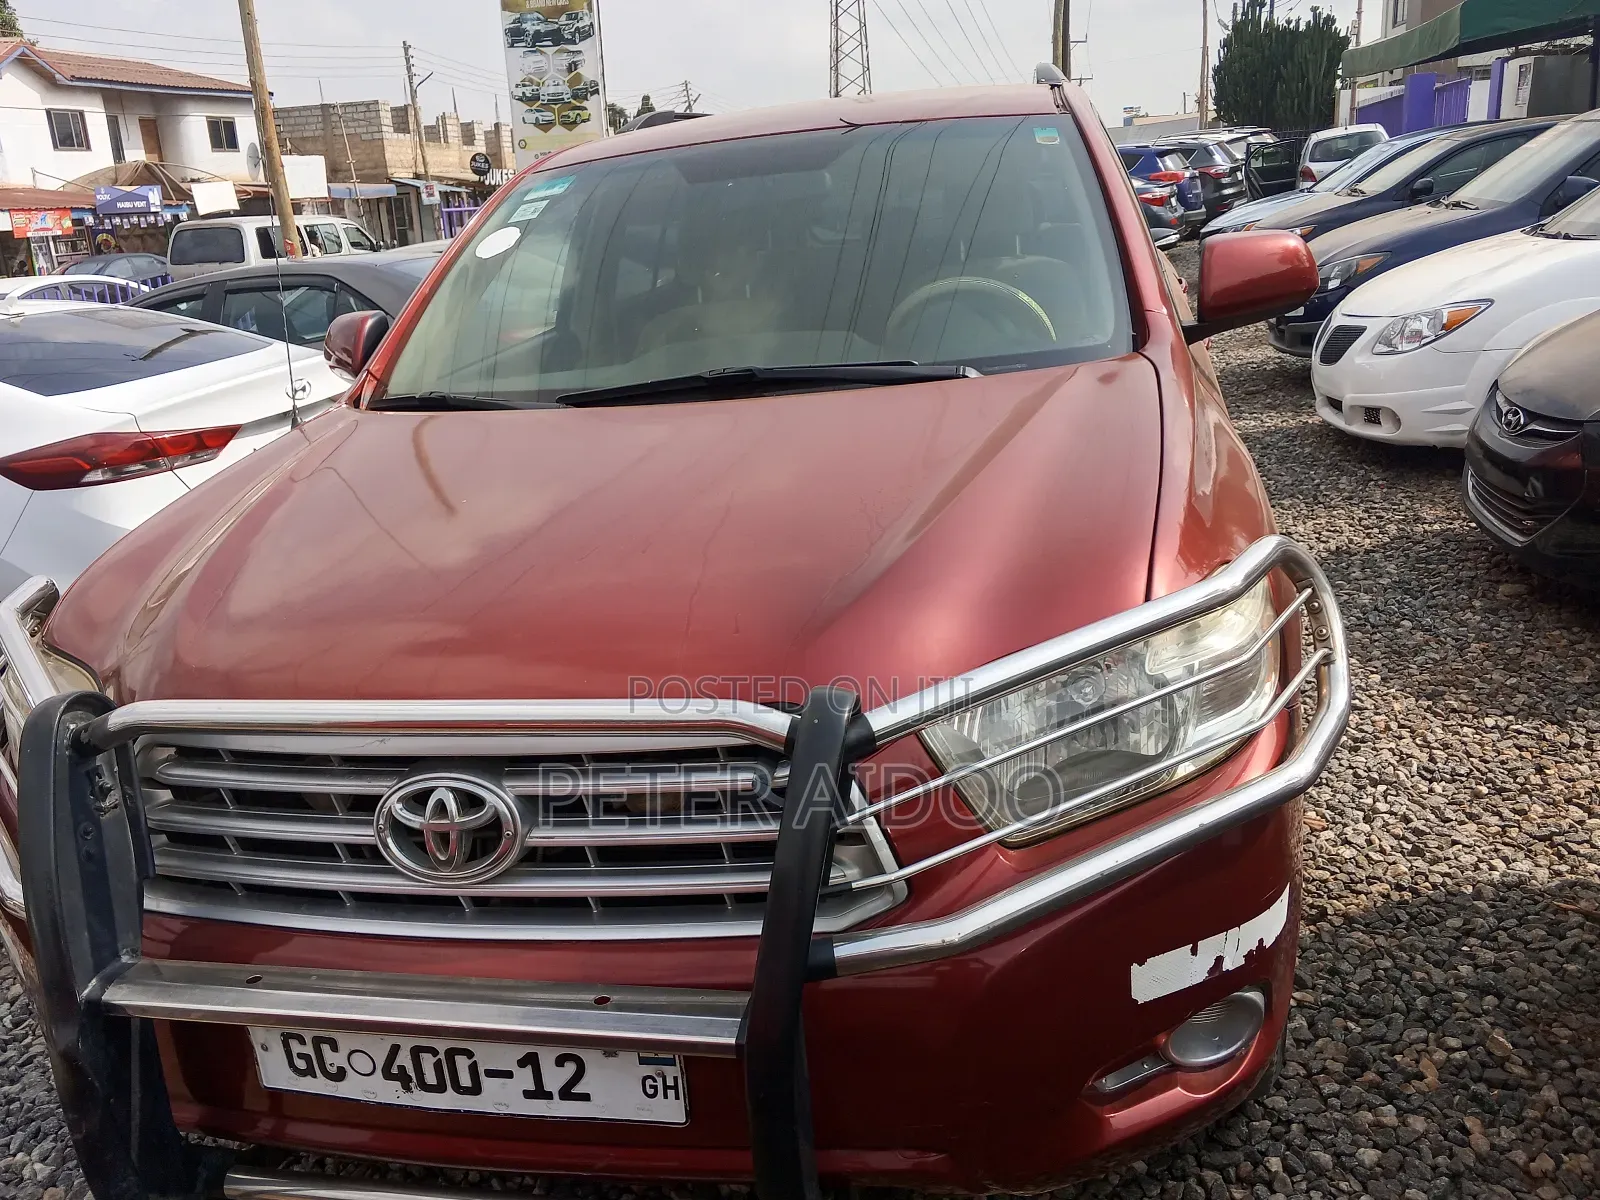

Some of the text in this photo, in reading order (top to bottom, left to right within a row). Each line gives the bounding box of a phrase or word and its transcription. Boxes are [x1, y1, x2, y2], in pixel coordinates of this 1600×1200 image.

[280, 1031, 591, 1102] GC 400-12
[641, 1074, 680, 1101] GH
